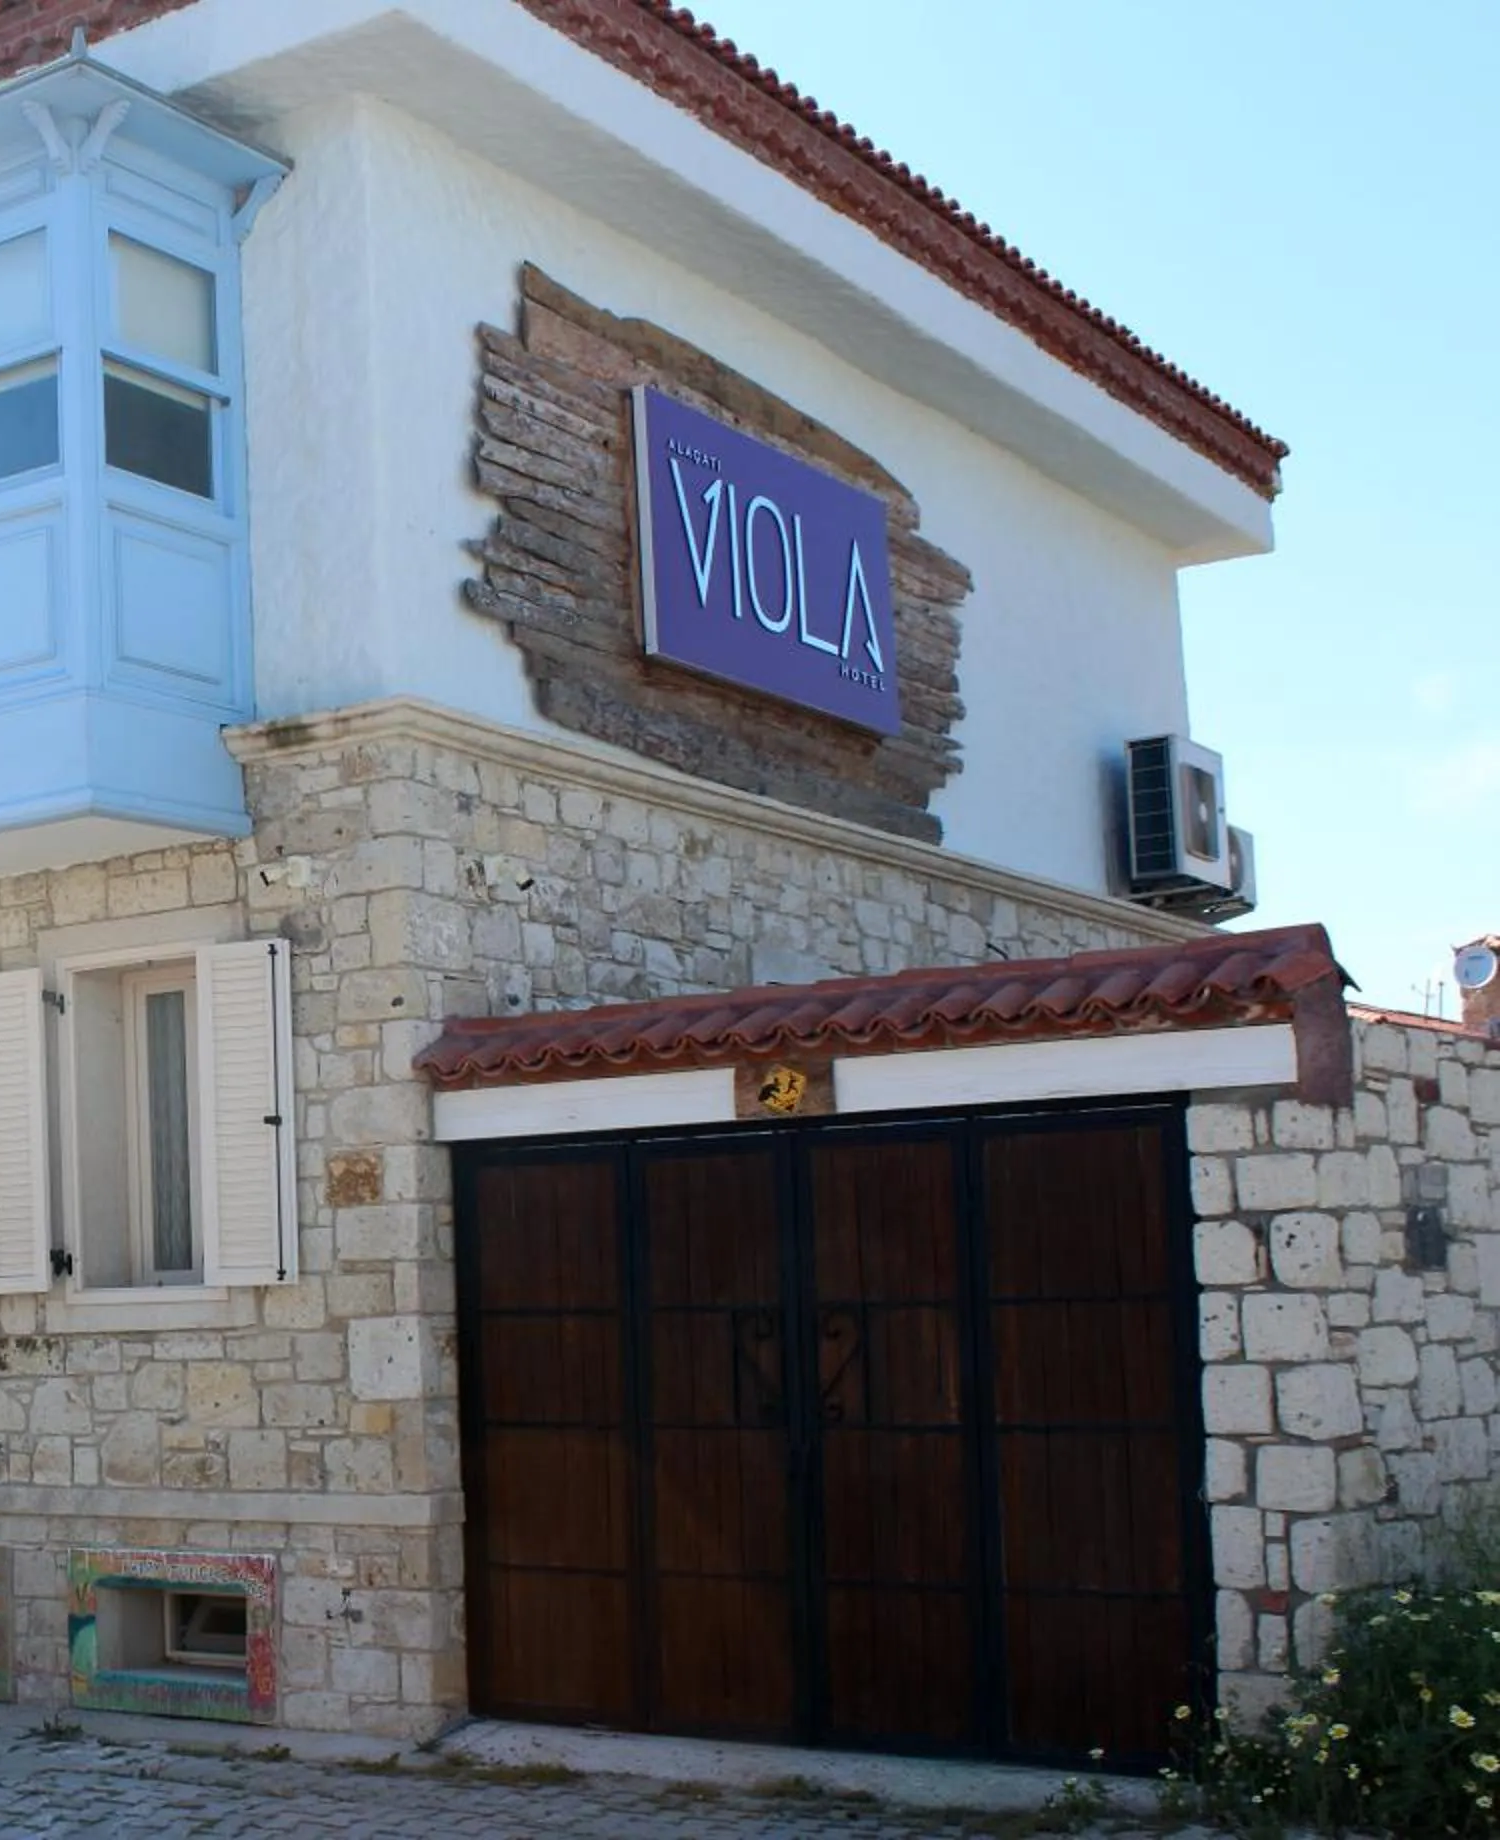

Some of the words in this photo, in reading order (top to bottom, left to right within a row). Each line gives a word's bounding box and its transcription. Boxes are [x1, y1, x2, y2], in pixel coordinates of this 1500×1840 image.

[668, 438, 722, 473] ALAÇATI
[669, 457, 885, 673] VIOLA
[840, 662, 885, 691] HOTEL
